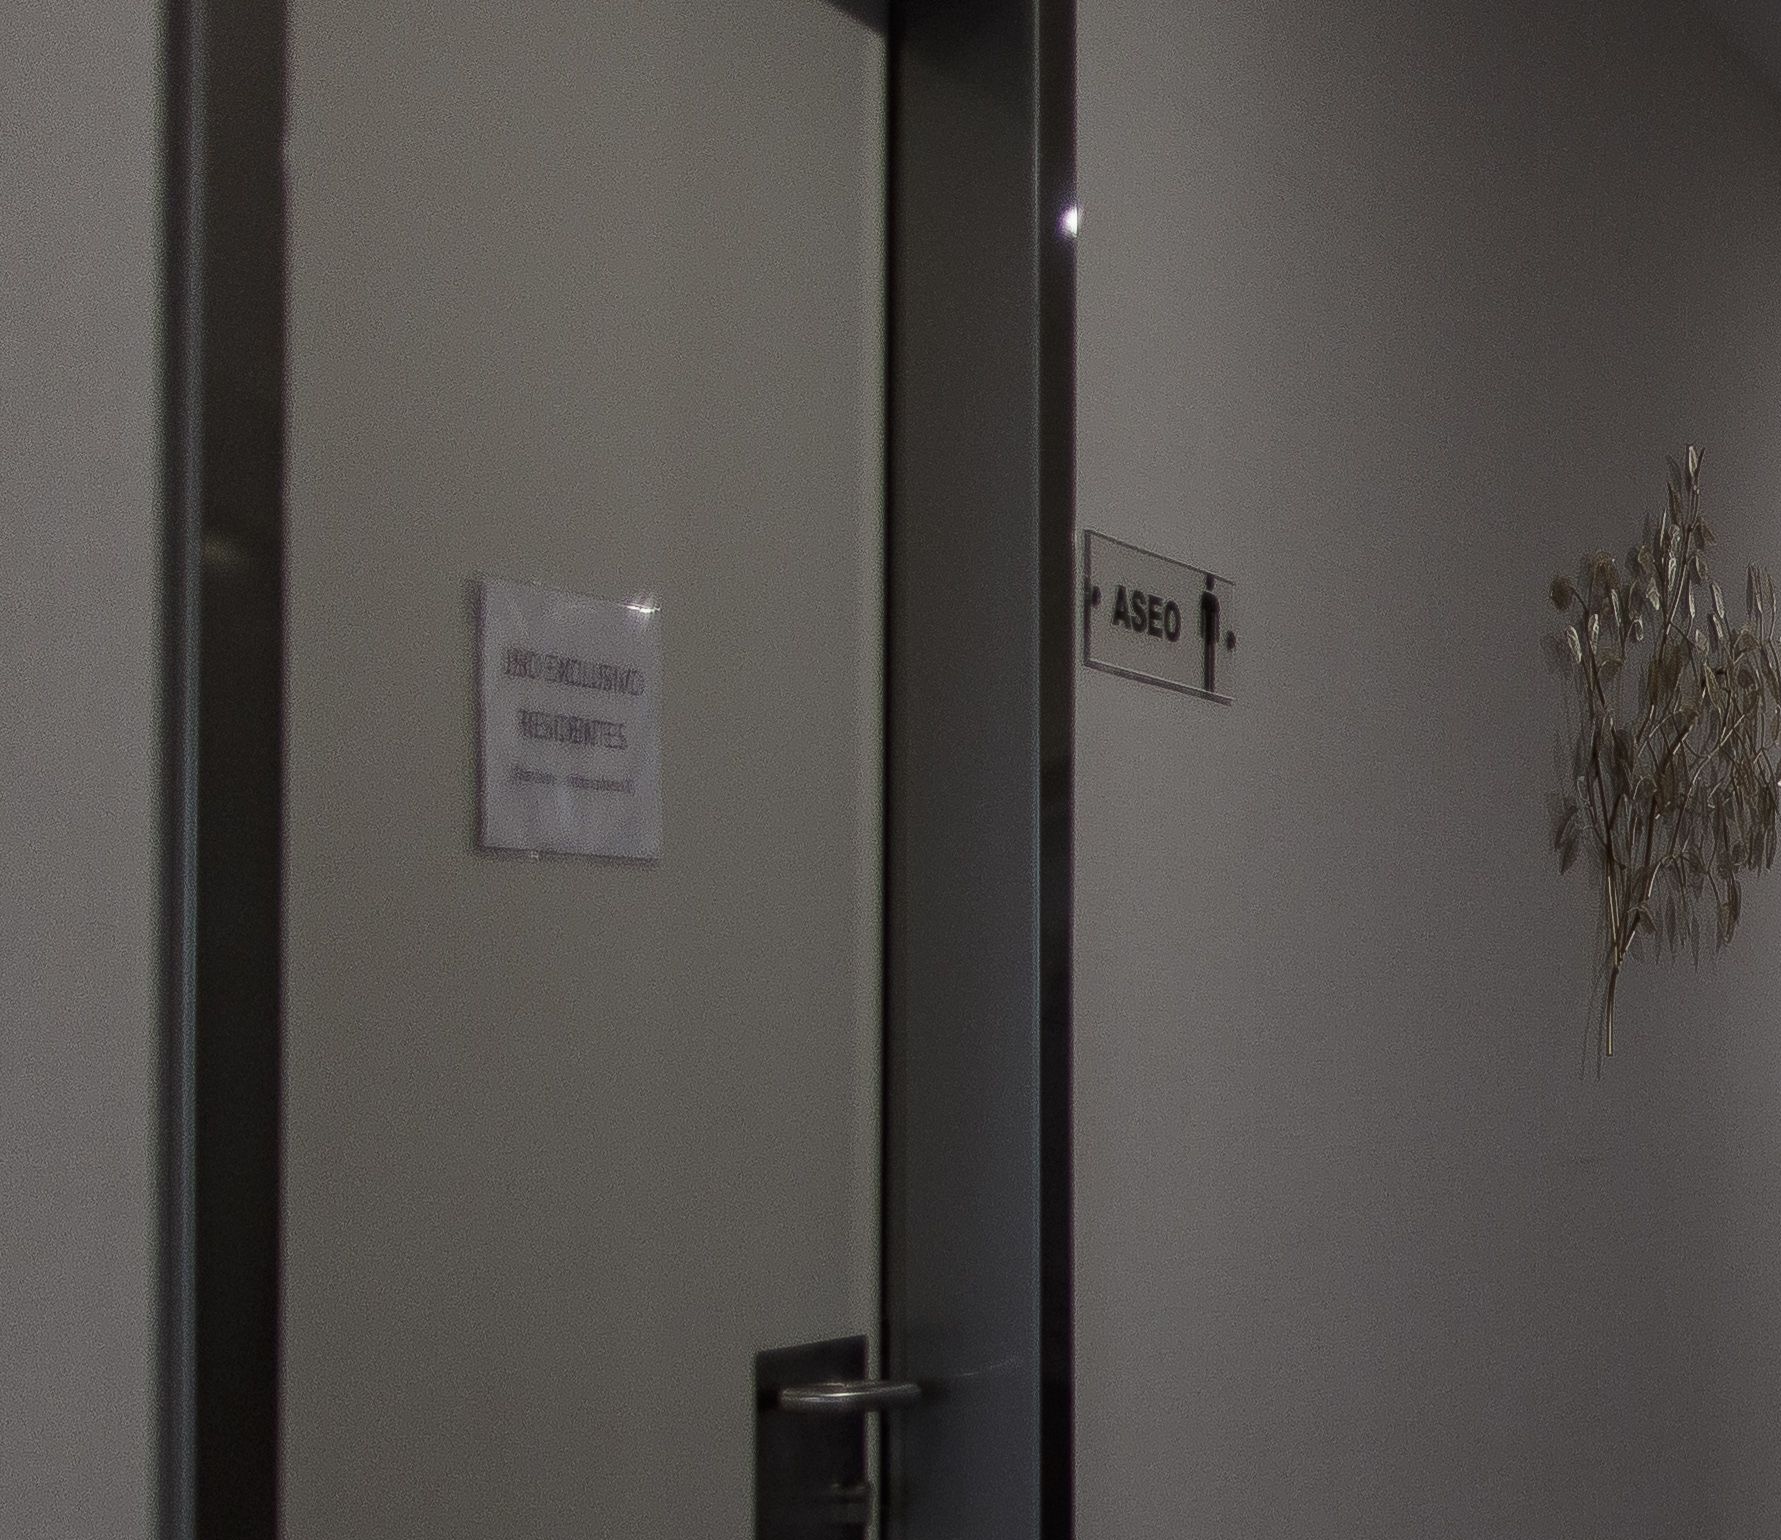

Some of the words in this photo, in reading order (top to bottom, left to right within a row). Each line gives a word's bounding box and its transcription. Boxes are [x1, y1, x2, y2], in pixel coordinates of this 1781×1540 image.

[1112, 584, 1182, 643] ASEO
[545, 653, 645, 696] EXCLUSIVO
[517, 708, 628, 750] RESIDENTES
